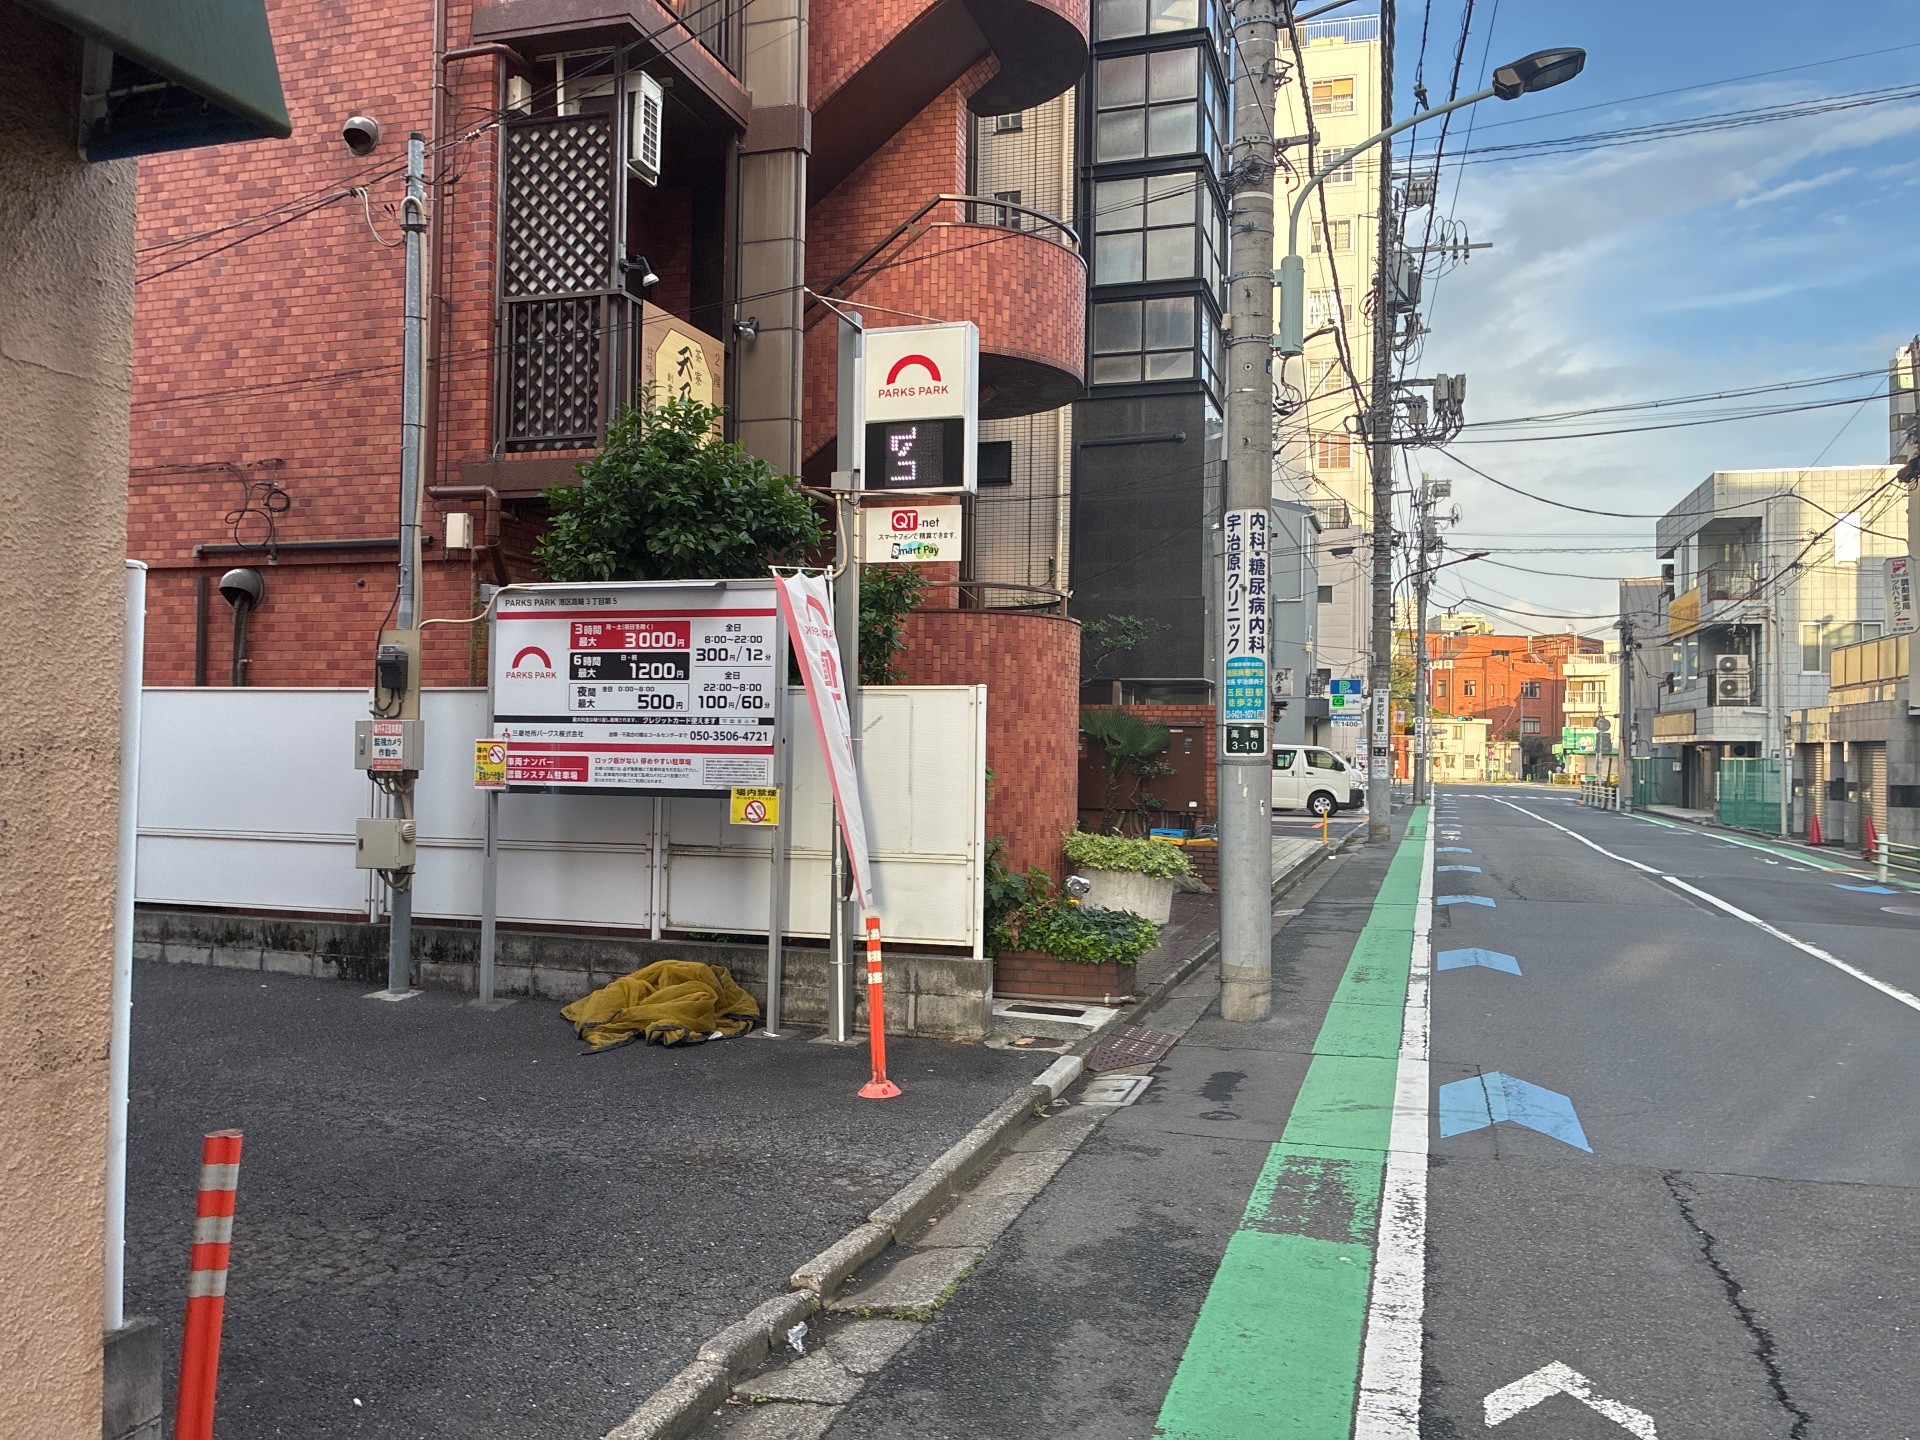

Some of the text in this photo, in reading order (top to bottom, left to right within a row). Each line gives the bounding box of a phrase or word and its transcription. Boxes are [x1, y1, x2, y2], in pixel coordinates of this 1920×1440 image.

[878, 385, 949, 398] PARKS PARK
[892, 512, 940, 529] QT-net
[923, 545, 940, 557] Pay
[1226, 513, 1242, 655] 宇治原クリニック
[1248, 511, 1266, 655] 内科・糖尿病内科
[505, 599, 533, 607] PARKS
[534, 598, 556, 606] PARK
[574, 623, 603, 636] 3時間
[725, 623, 742, 632] 全日
[578, 637, 598, 647] 最大
[573, 654, 602, 667] 6時間
[505, 671, 557, 679] PARKS PARK
[577, 668, 597, 678] 最大
[724, 670, 741, 680] 全日
[577, 686, 597, 697] 夜間
[1227, 688, 1264, 697] 五反田駅
[577, 699, 596, 709] 最大
[1228, 698, 1262, 707] 徒歩2分
[689, 730, 768, 742] 050-3506-4721
[373, 737, 402, 747] 監視カメラ
[1231, 741, 1258, 750] 3-10
[378, 748, 398, 758] 作動中
